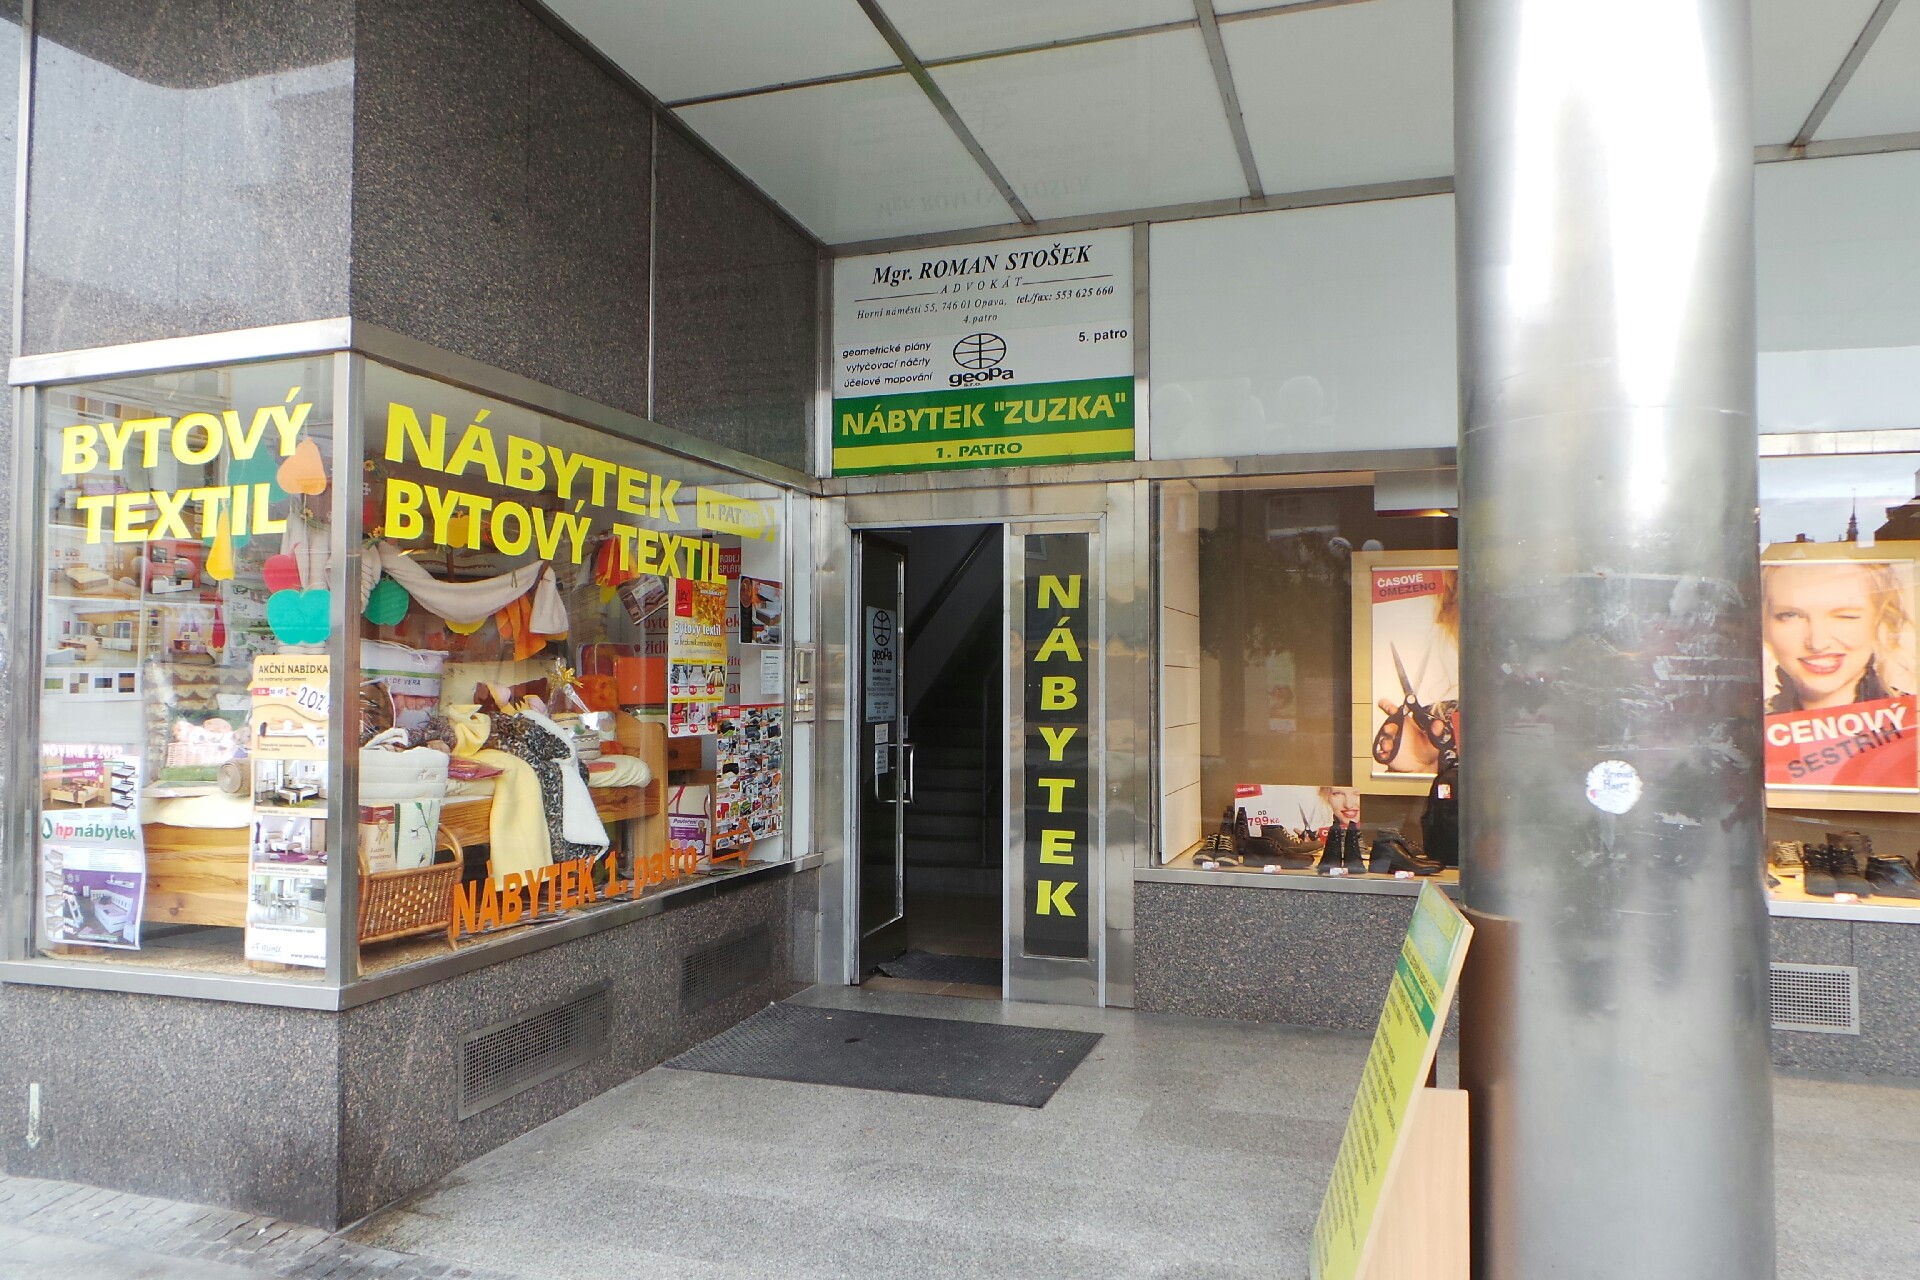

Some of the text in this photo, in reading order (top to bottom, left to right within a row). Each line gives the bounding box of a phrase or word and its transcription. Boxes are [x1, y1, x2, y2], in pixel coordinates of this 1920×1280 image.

[872, 243, 1093, 287] Mgr. ROMAN STOŠEK
[924, 303, 938, 313] 55,
[942, 300, 958, 311] 746
[960, 299, 971, 309] 01
[974, 297, 1007, 309] Opava,
[1016, 292, 1052, 305] tel./fax:
[1055, 289, 1072, 300] 553
[1075, 287, 1094, 298] 625
[1096, 285, 1114, 296] 660
[1078, 329, 1128, 343] 5. patro
[842, 341, 932, 359] geometrické plány
[846, 357, 931, 374] vytyčovací náčrty
[844, 371, 934, 388] účelové mapování
[842, 392, 1126, 436] NÁBYTEK "ZUZKA"
[61, 386, 313, 475] BYTOVÝ
[936, 442, 1023, 459] 1. PATRO
[385, 402, 682, 524] NÁBYTEK
[77, 483, 288, 545] TEXTIL
[705, 501, 759, 528] 1. PATRO
[384, 478, 727, 586] BYTOVÝ TEXTIL
[719, 554, 740, 563] RODEJ
[1377, 572, 1424, 588] ČASOVĚ
[1379, 582, 1437, 597] OMEZENO
[674, 620, 721, 638] Bytový textil
[258, 662, 329, 674] AKČNÍ NABÍDKA
[298, 686, 326, 711] 20%
[1766, 702, 1908, 747] CENOVÝ
[42, 743, 96, 759] NOVINKY
[1034, 574, 1082, 917] NÁBYTEK
[1248, 816, 1269, 827] 799
[55, 822, 137, 841] hpnábytek
[452, 842, 697, 938] NÁBYTEK 1. patro
